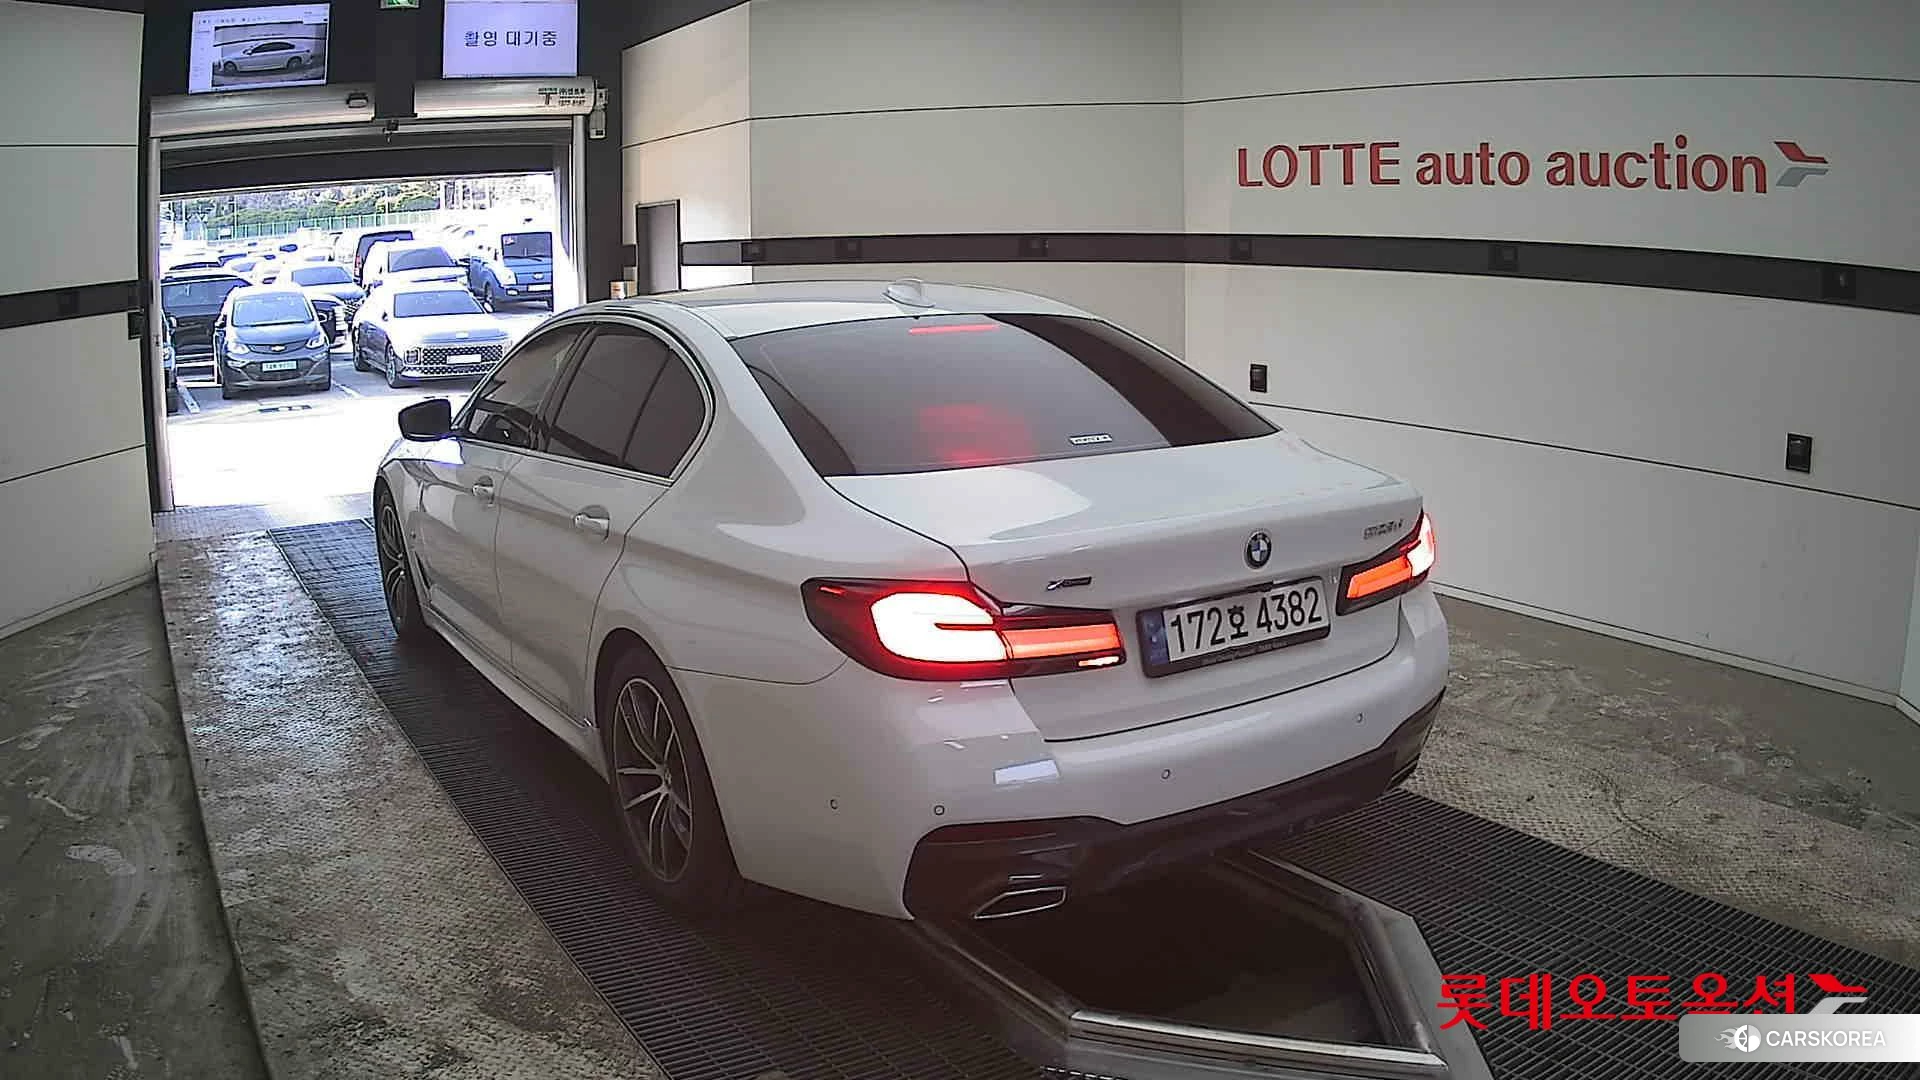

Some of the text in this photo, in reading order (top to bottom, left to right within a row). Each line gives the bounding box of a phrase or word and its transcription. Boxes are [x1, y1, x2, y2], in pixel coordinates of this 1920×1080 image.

[505, 30, 558, 47] 대기중
[1237, 133, 1768, 194] LOTTE auto auction
[1170, 604, 1249, 653] 172호
[1256, 586, 1322, 633] 4382
